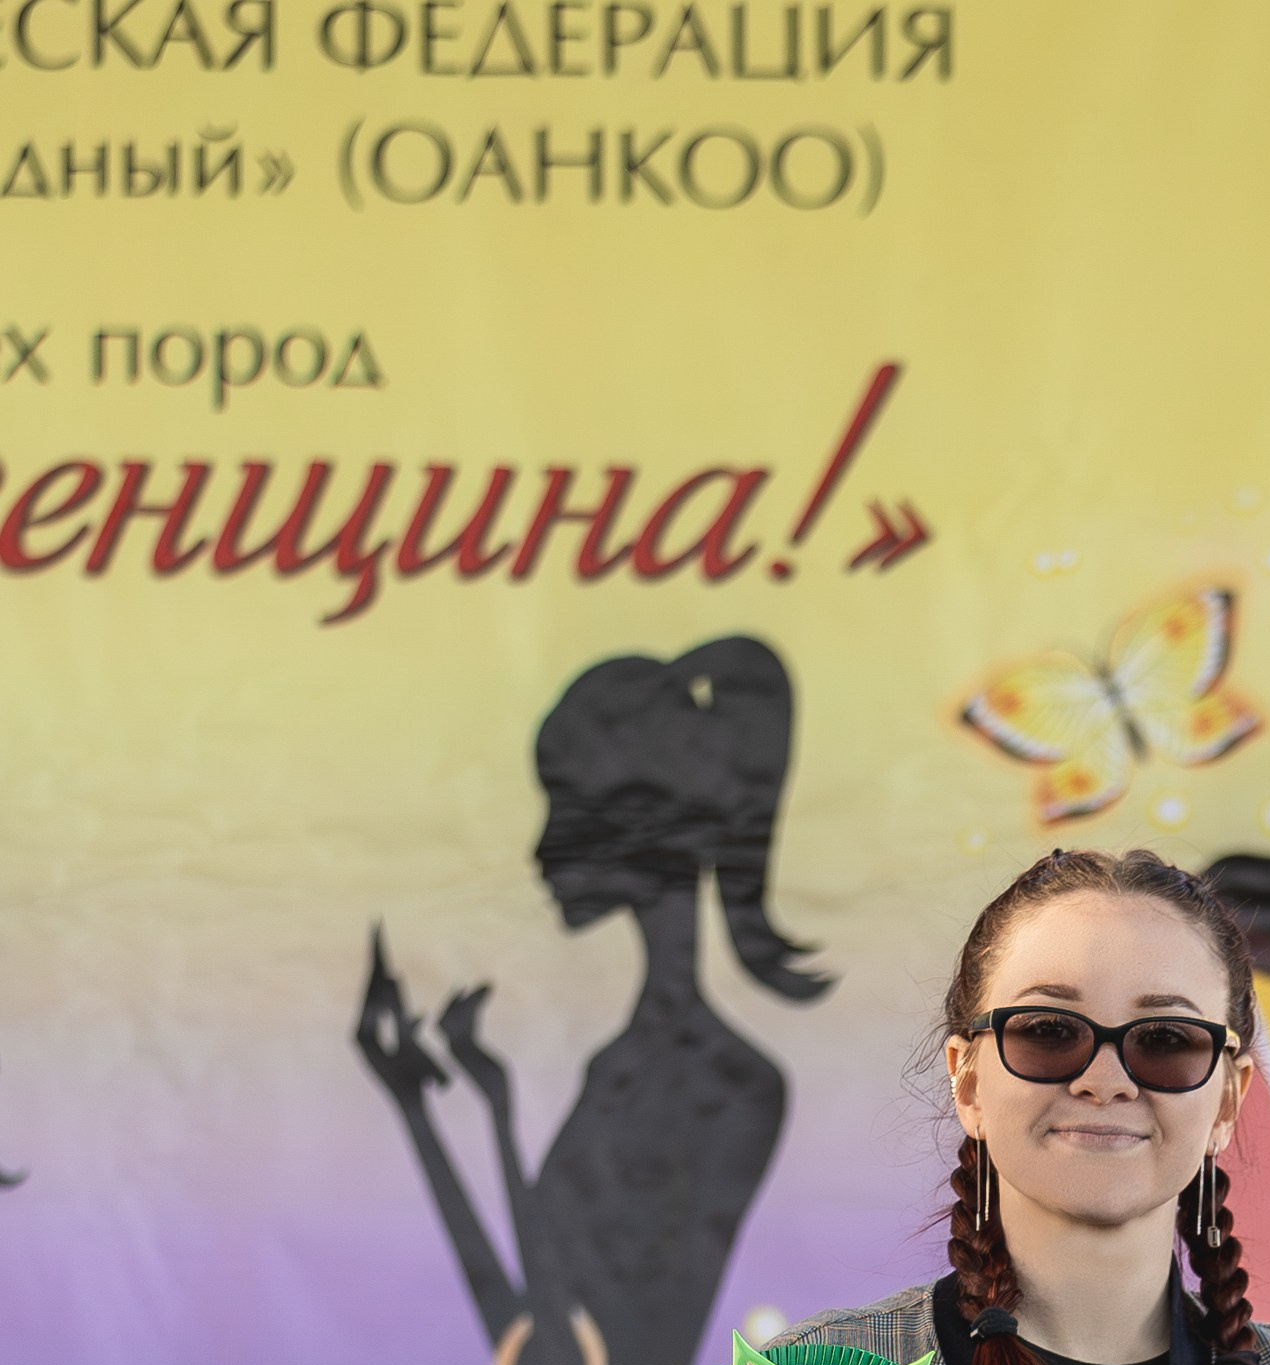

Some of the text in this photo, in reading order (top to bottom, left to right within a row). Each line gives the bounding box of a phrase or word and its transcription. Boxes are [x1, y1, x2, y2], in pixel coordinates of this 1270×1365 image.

[0, 0, 955, 83] СКАЯ ФЕДЕРАЦИЯ
[337, 115, 887, 218] (ОАНКОО)
[0, 323, 387, 410] х пород
[0, 359, 934, 627] енщина!»
